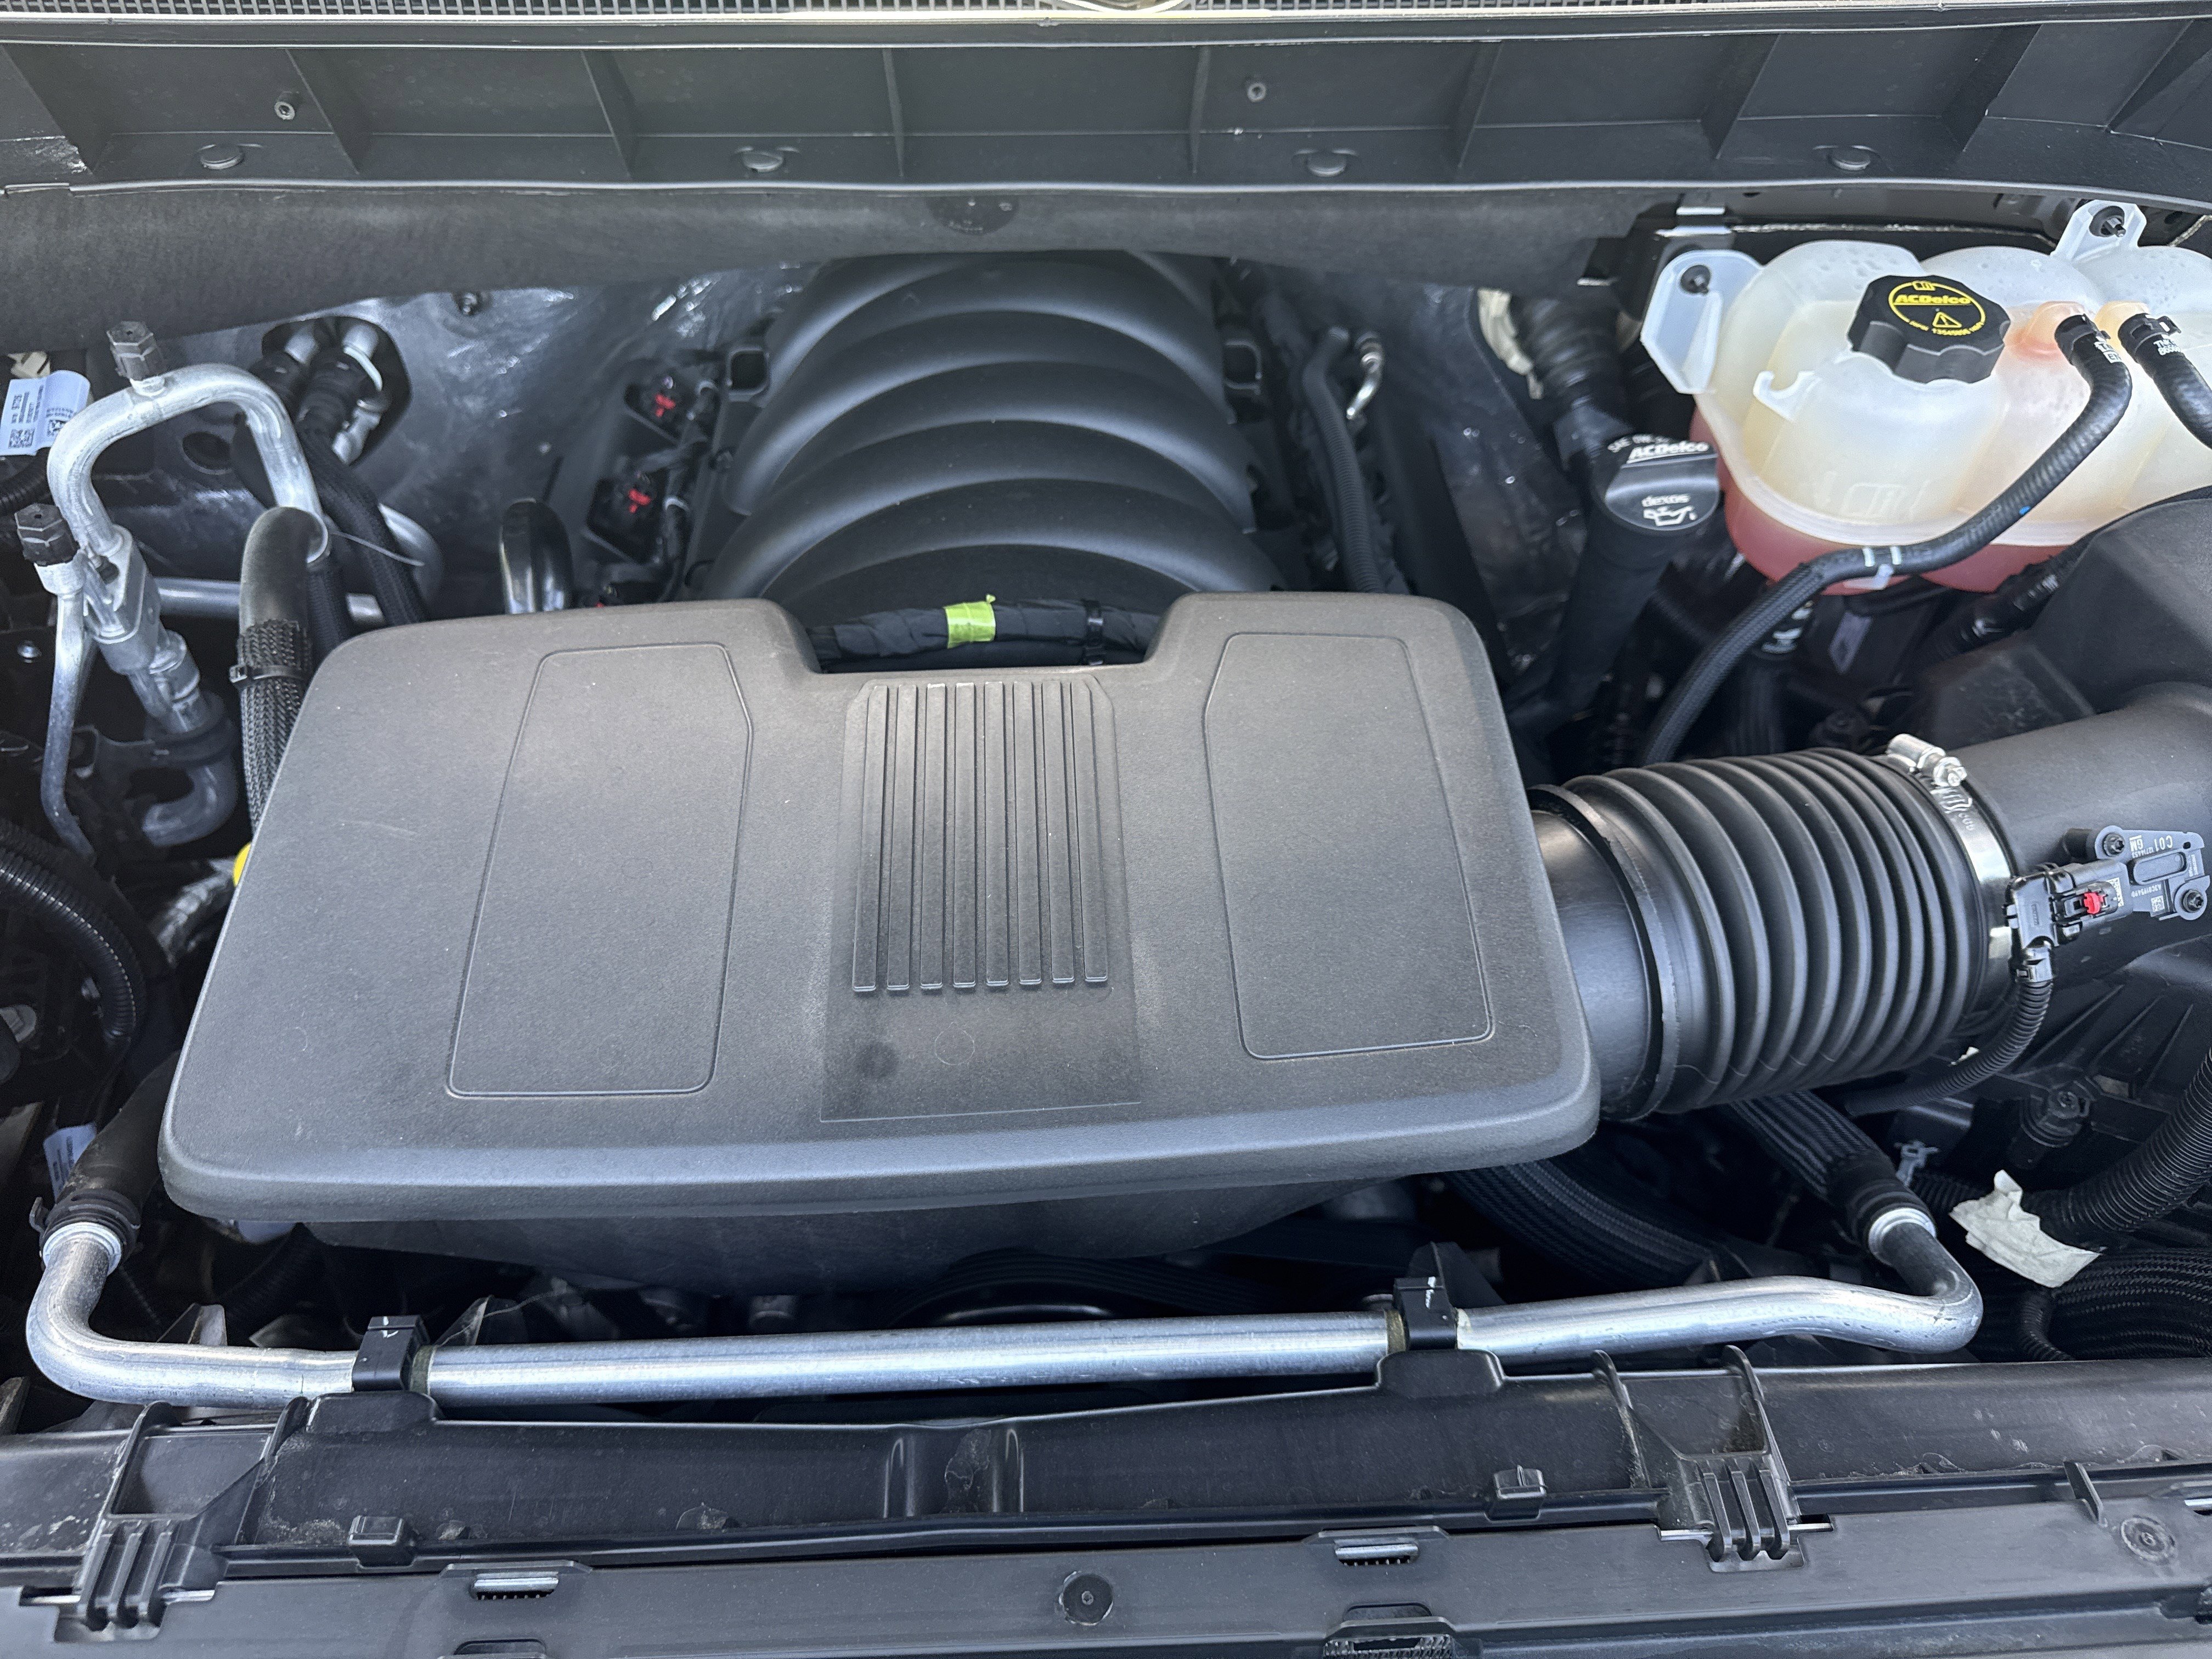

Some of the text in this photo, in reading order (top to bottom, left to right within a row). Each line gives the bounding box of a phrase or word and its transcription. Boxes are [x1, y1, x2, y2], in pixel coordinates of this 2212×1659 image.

[1894, 294, 1971, 304] ACDelco
[1628, 441, 1710, 460] ACDelco
[1641, 493, 1691, 507] dexos
[2129, 837, 2144, 852] GM
